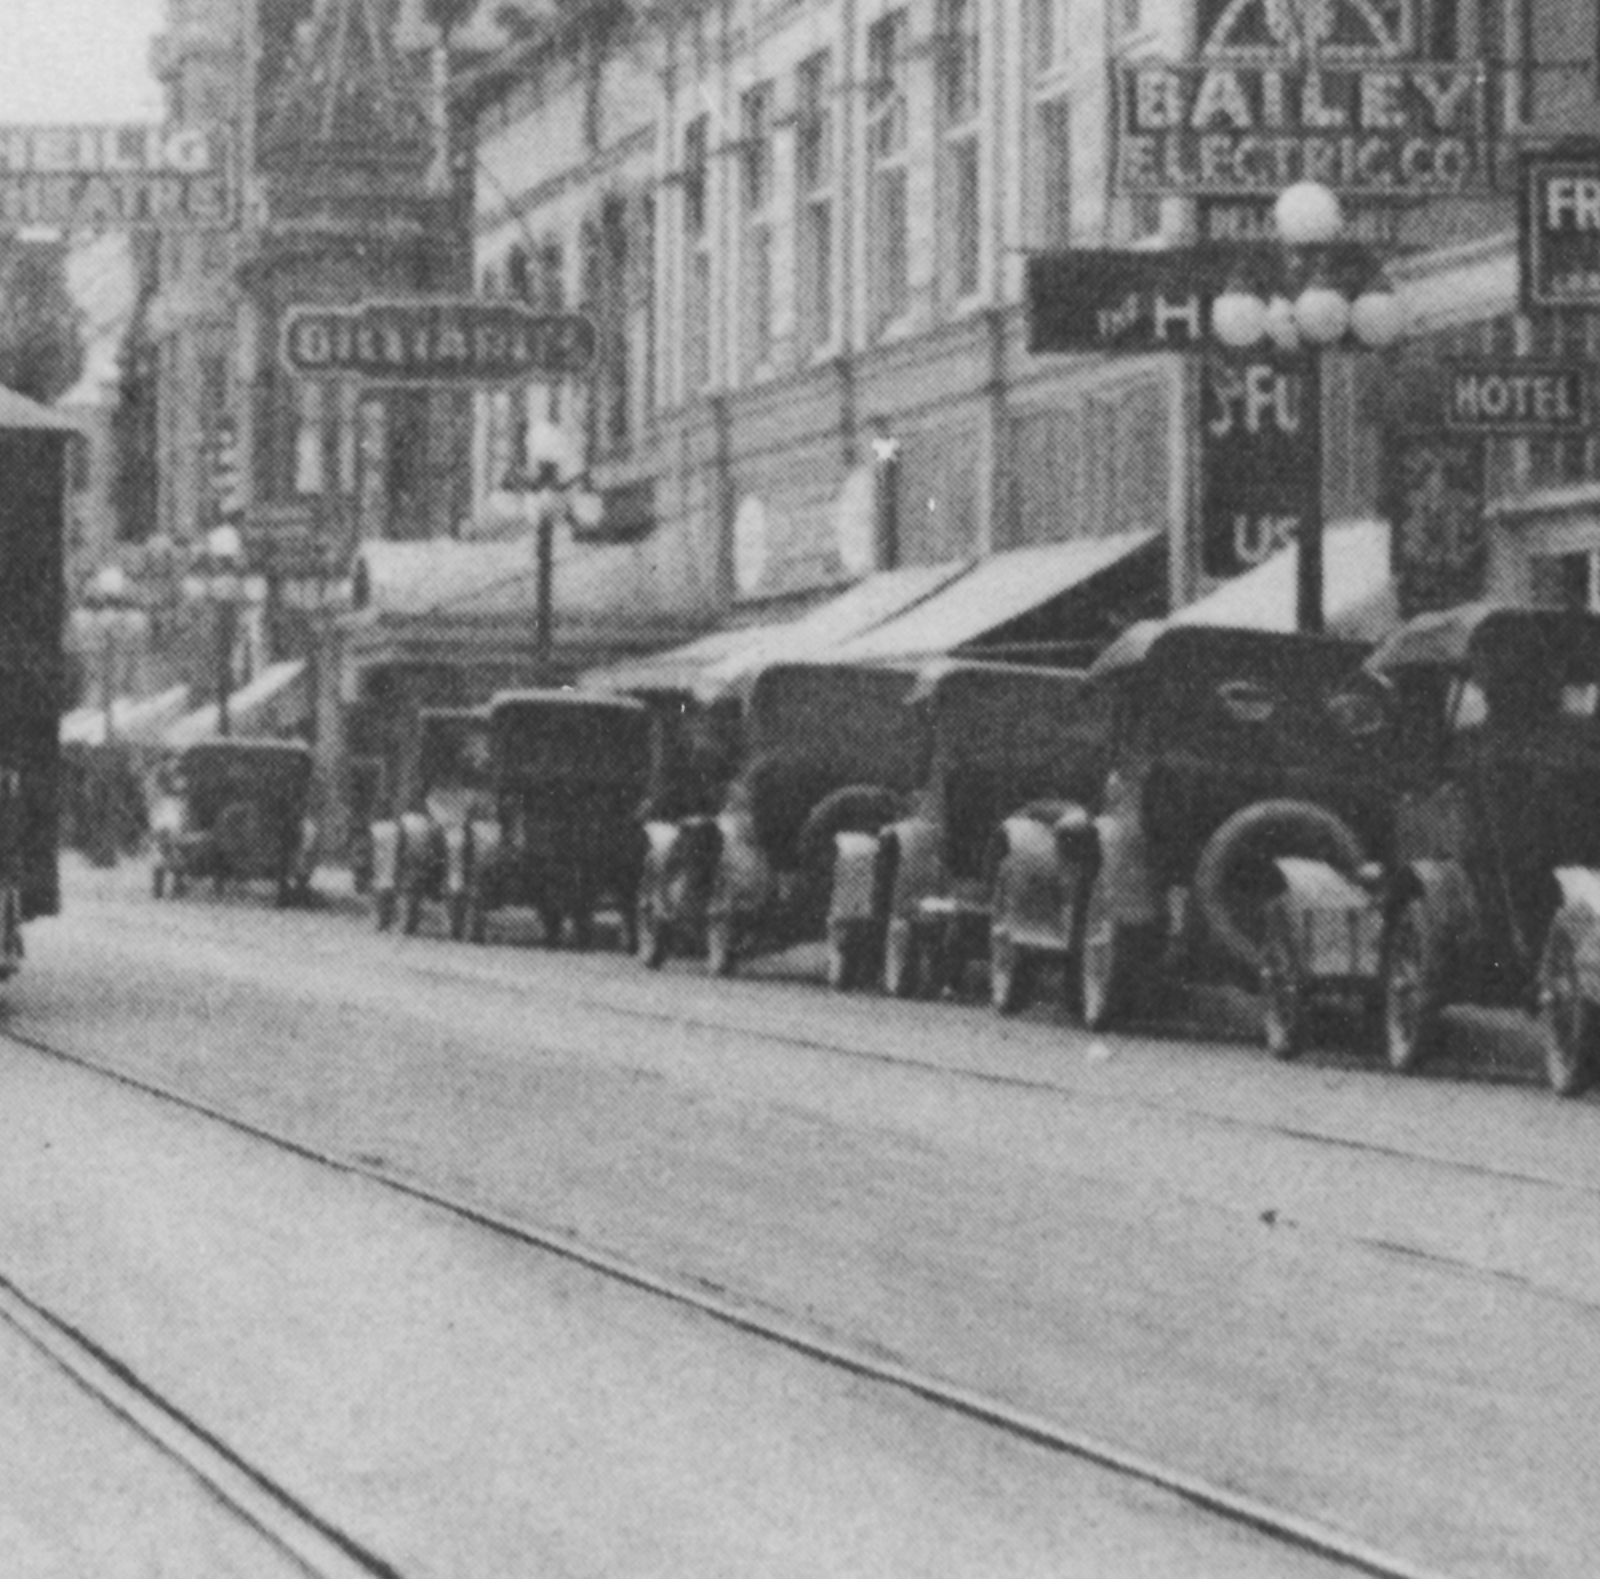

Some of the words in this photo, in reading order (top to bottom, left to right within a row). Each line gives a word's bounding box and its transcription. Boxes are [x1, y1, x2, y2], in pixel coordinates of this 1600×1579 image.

[1134, 69, 1472, 129] BAILEY
[1119, 134, 1395, 187] ELECTRIC
[1455, 376, 1575, 419] HOTEL
